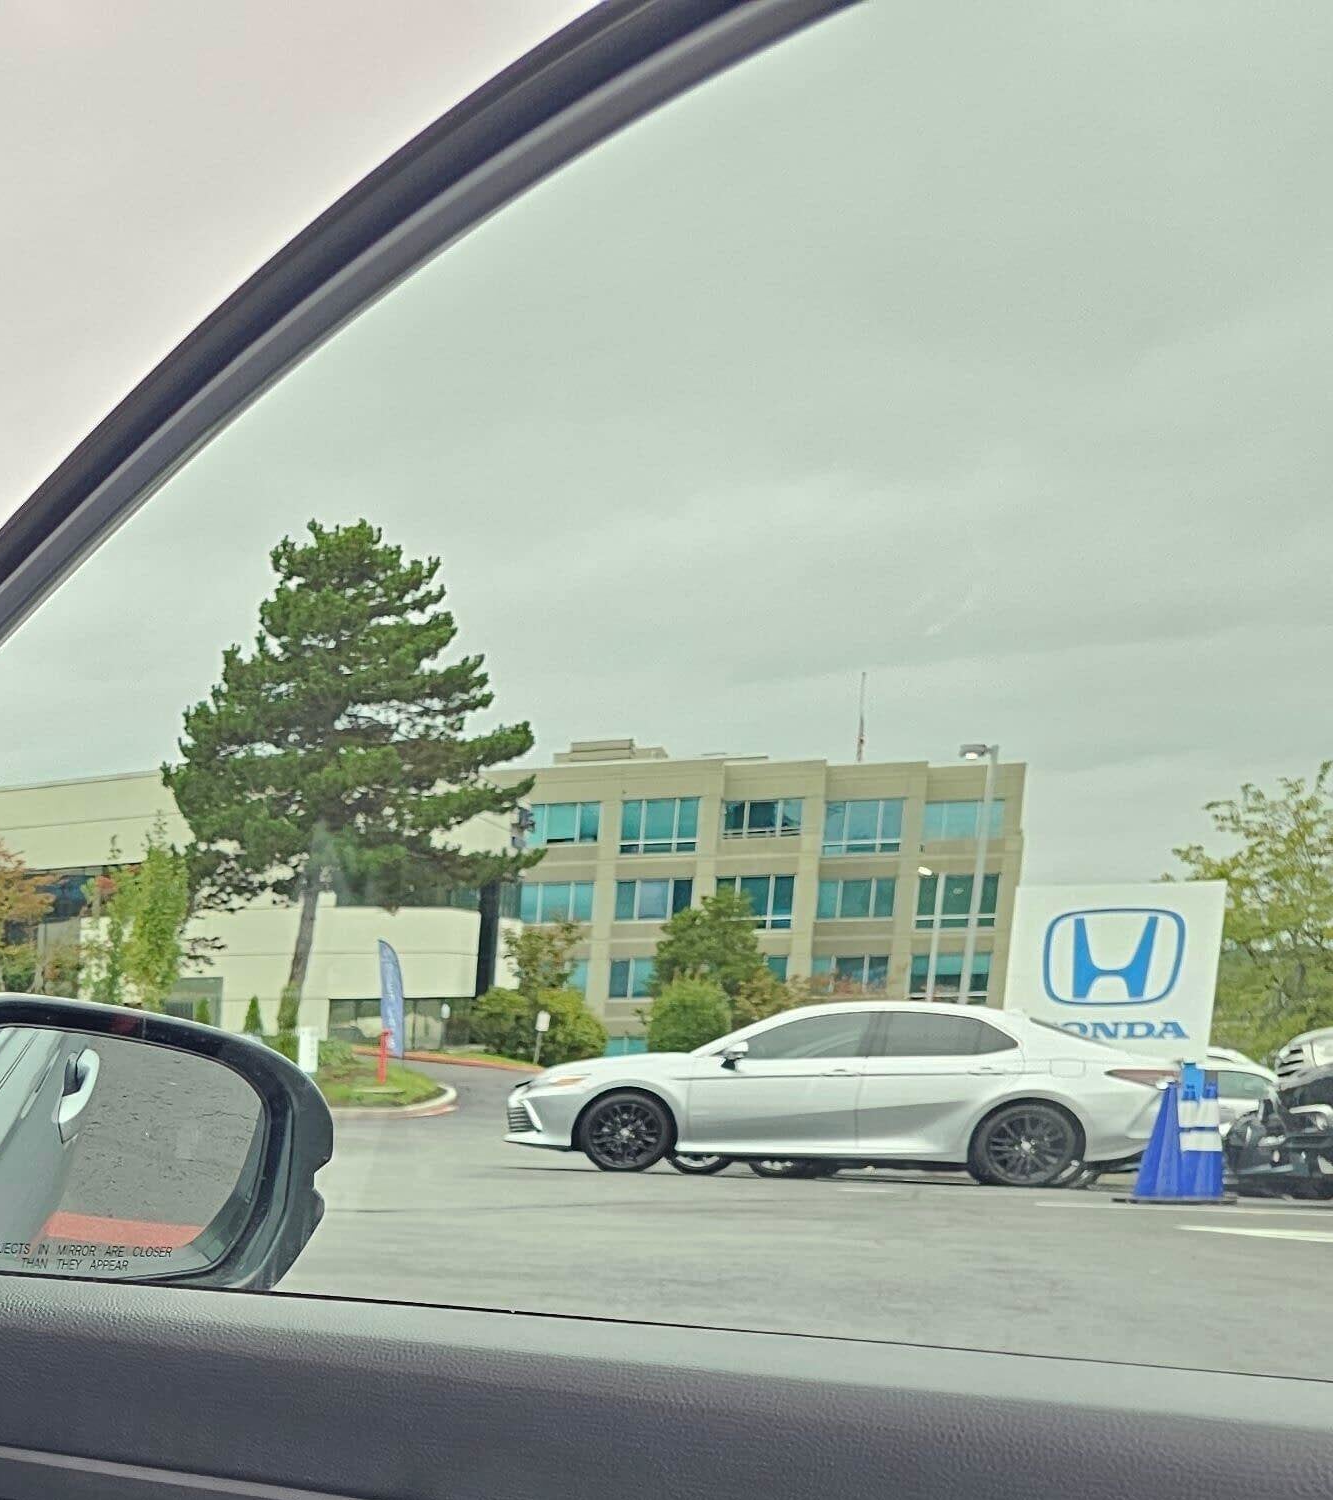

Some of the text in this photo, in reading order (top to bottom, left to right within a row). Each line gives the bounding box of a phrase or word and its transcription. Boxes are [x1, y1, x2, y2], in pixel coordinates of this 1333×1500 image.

[1053, 1020, 1190, 1040] ONDA
[37, 1244, 49, 1255] IN
[57, 1244, 96, 1258] MIRROR
[105, 1245, 125, 1258] ARE
[132, 1245, 173, 1259] CLOSER
[21, 1256, 130, 1272] THAN THEY APPEAR
